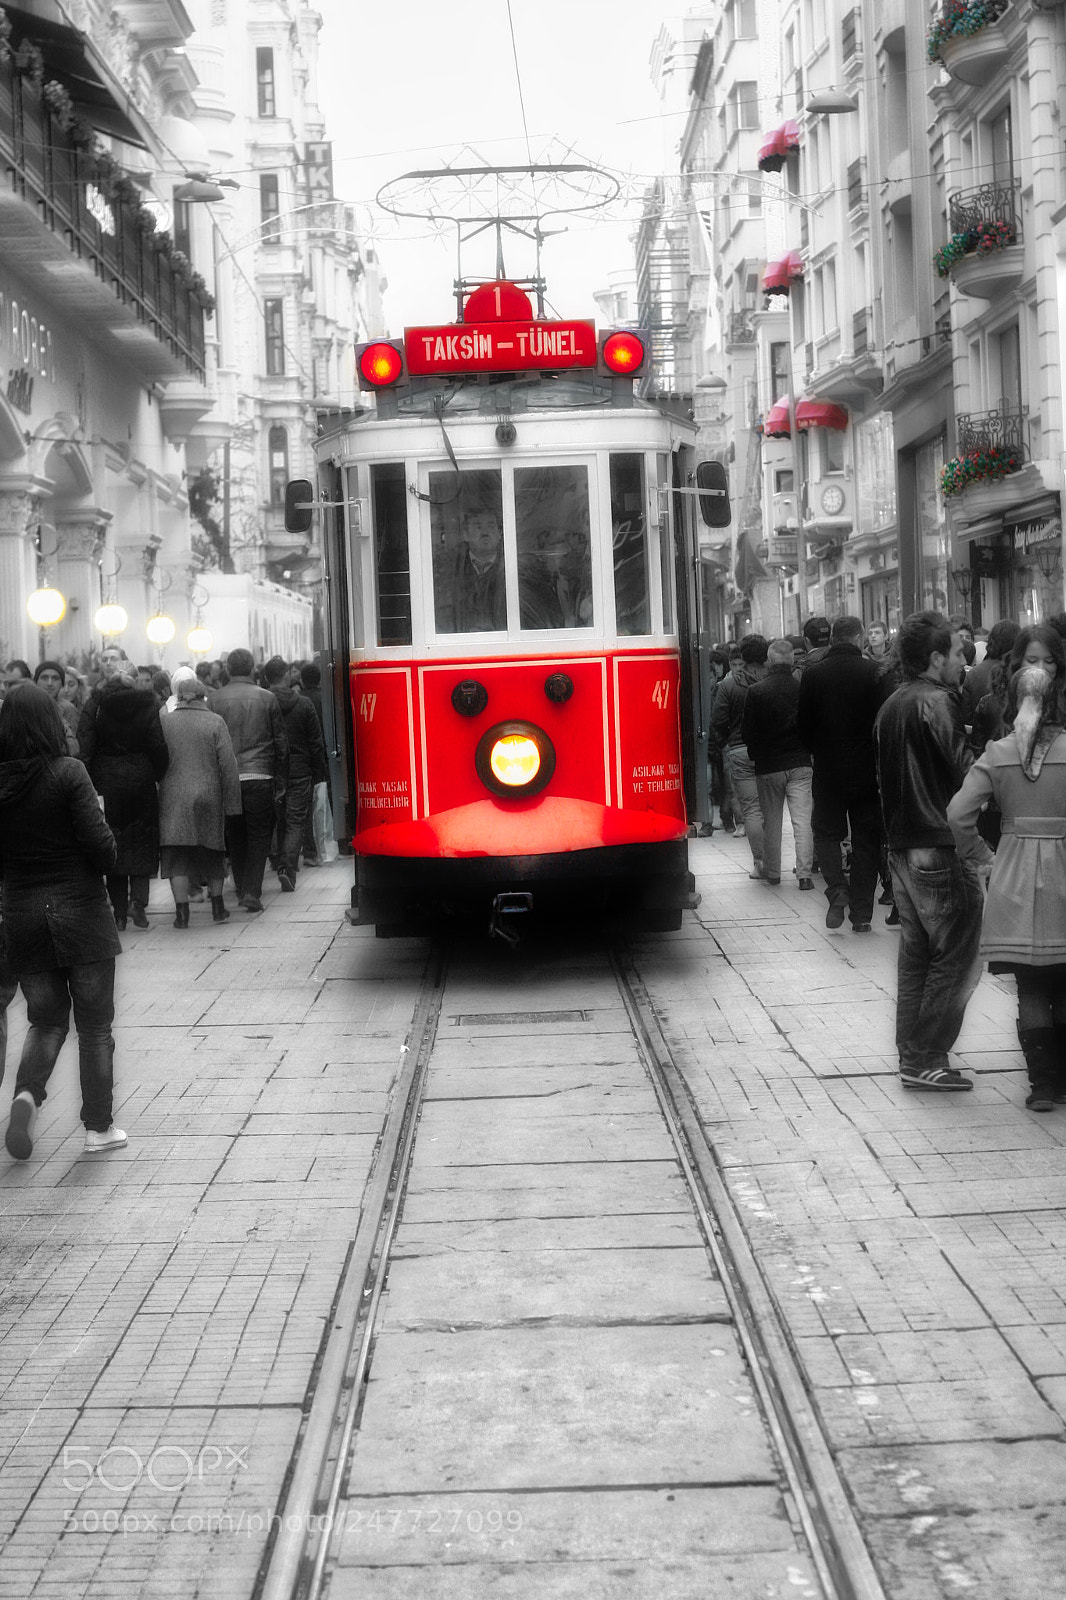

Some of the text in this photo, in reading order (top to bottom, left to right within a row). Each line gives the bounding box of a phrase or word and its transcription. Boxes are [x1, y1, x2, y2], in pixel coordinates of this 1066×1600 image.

[493, 286, 501, 317] 1
[516, 327, 583, 357] TÜNEL
[360, 693, 377, 722] 47
[651, 679, 670, 710] 47
[381, 780, 408, 793] YASAK
[632, 782, 644, 793] VE
